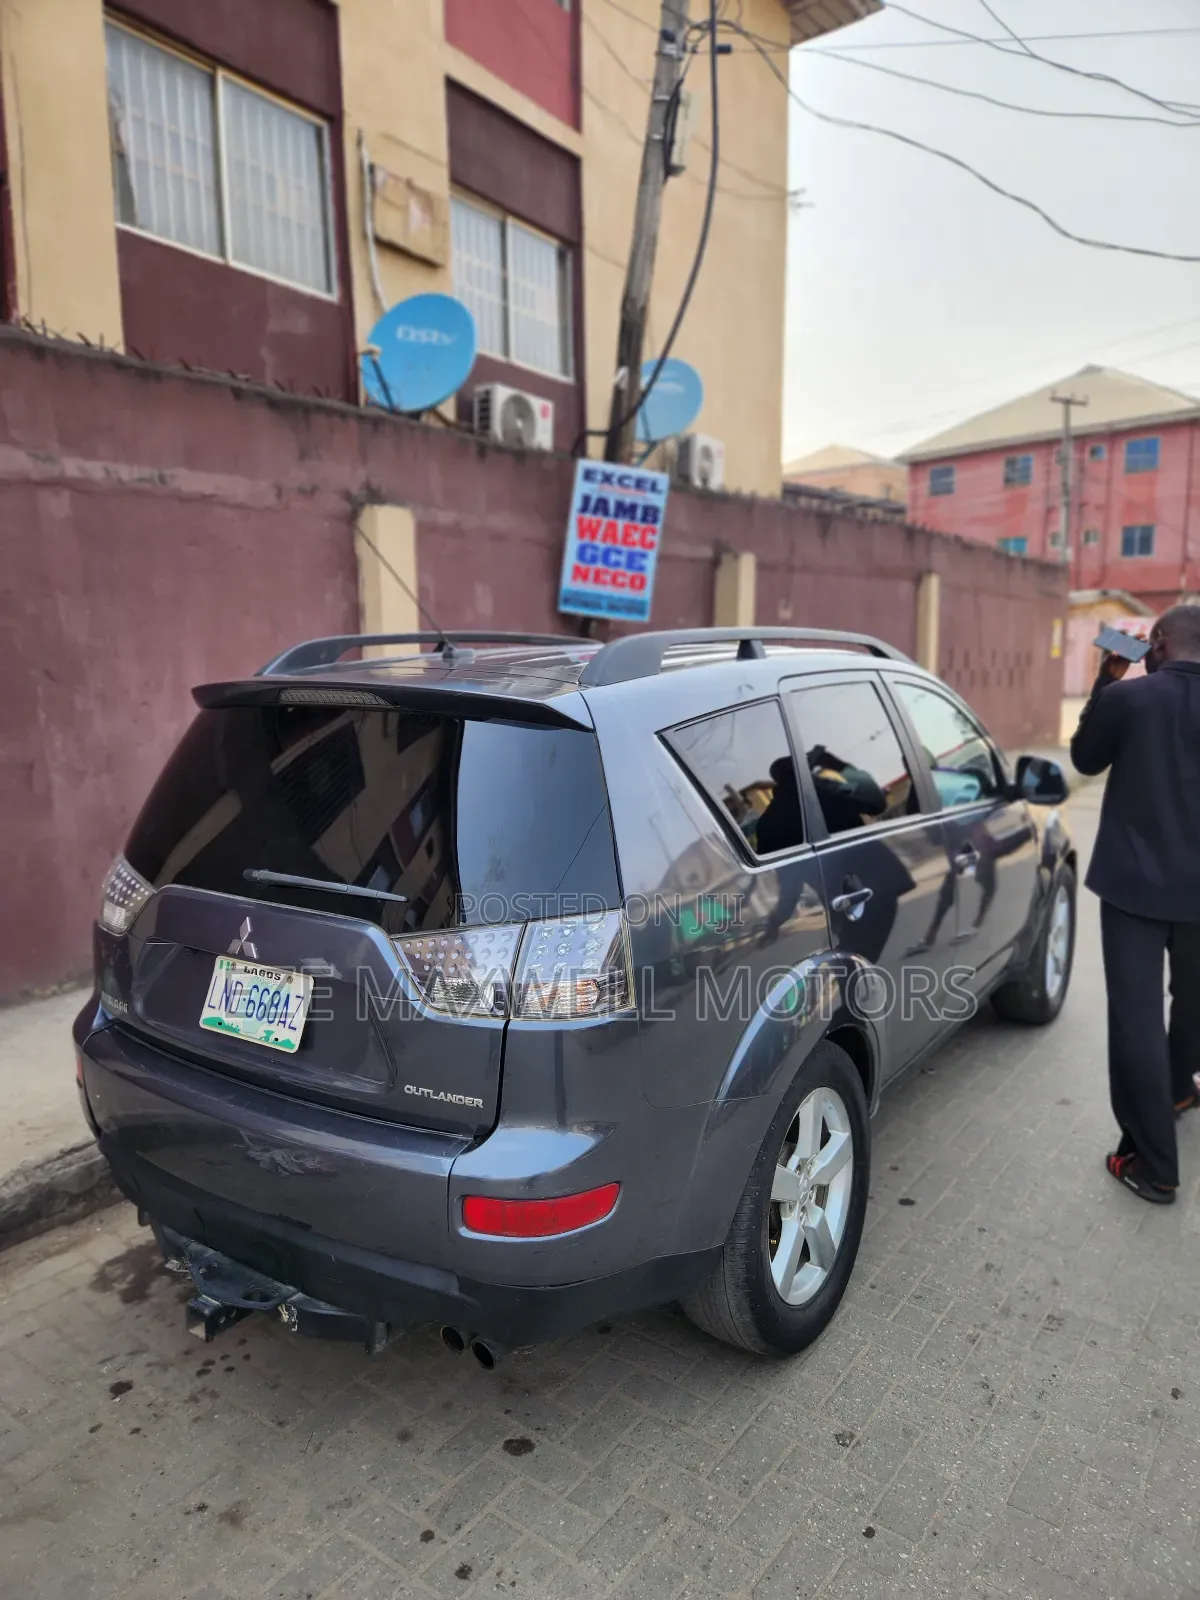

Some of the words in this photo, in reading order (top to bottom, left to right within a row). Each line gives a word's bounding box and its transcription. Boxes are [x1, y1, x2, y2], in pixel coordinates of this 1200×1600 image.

[582, 468, 663, 494] EXCEL
[578, 494, 661, 524] JAMB
[577, 515, 657, 550] WAEC
[577, 542, 648, 572] GCE
[572, 564, 647, 591] NECO
[243, 965, 282, 981] LAGOS
[404, 1084, 484, 1109] OUTLANDER
